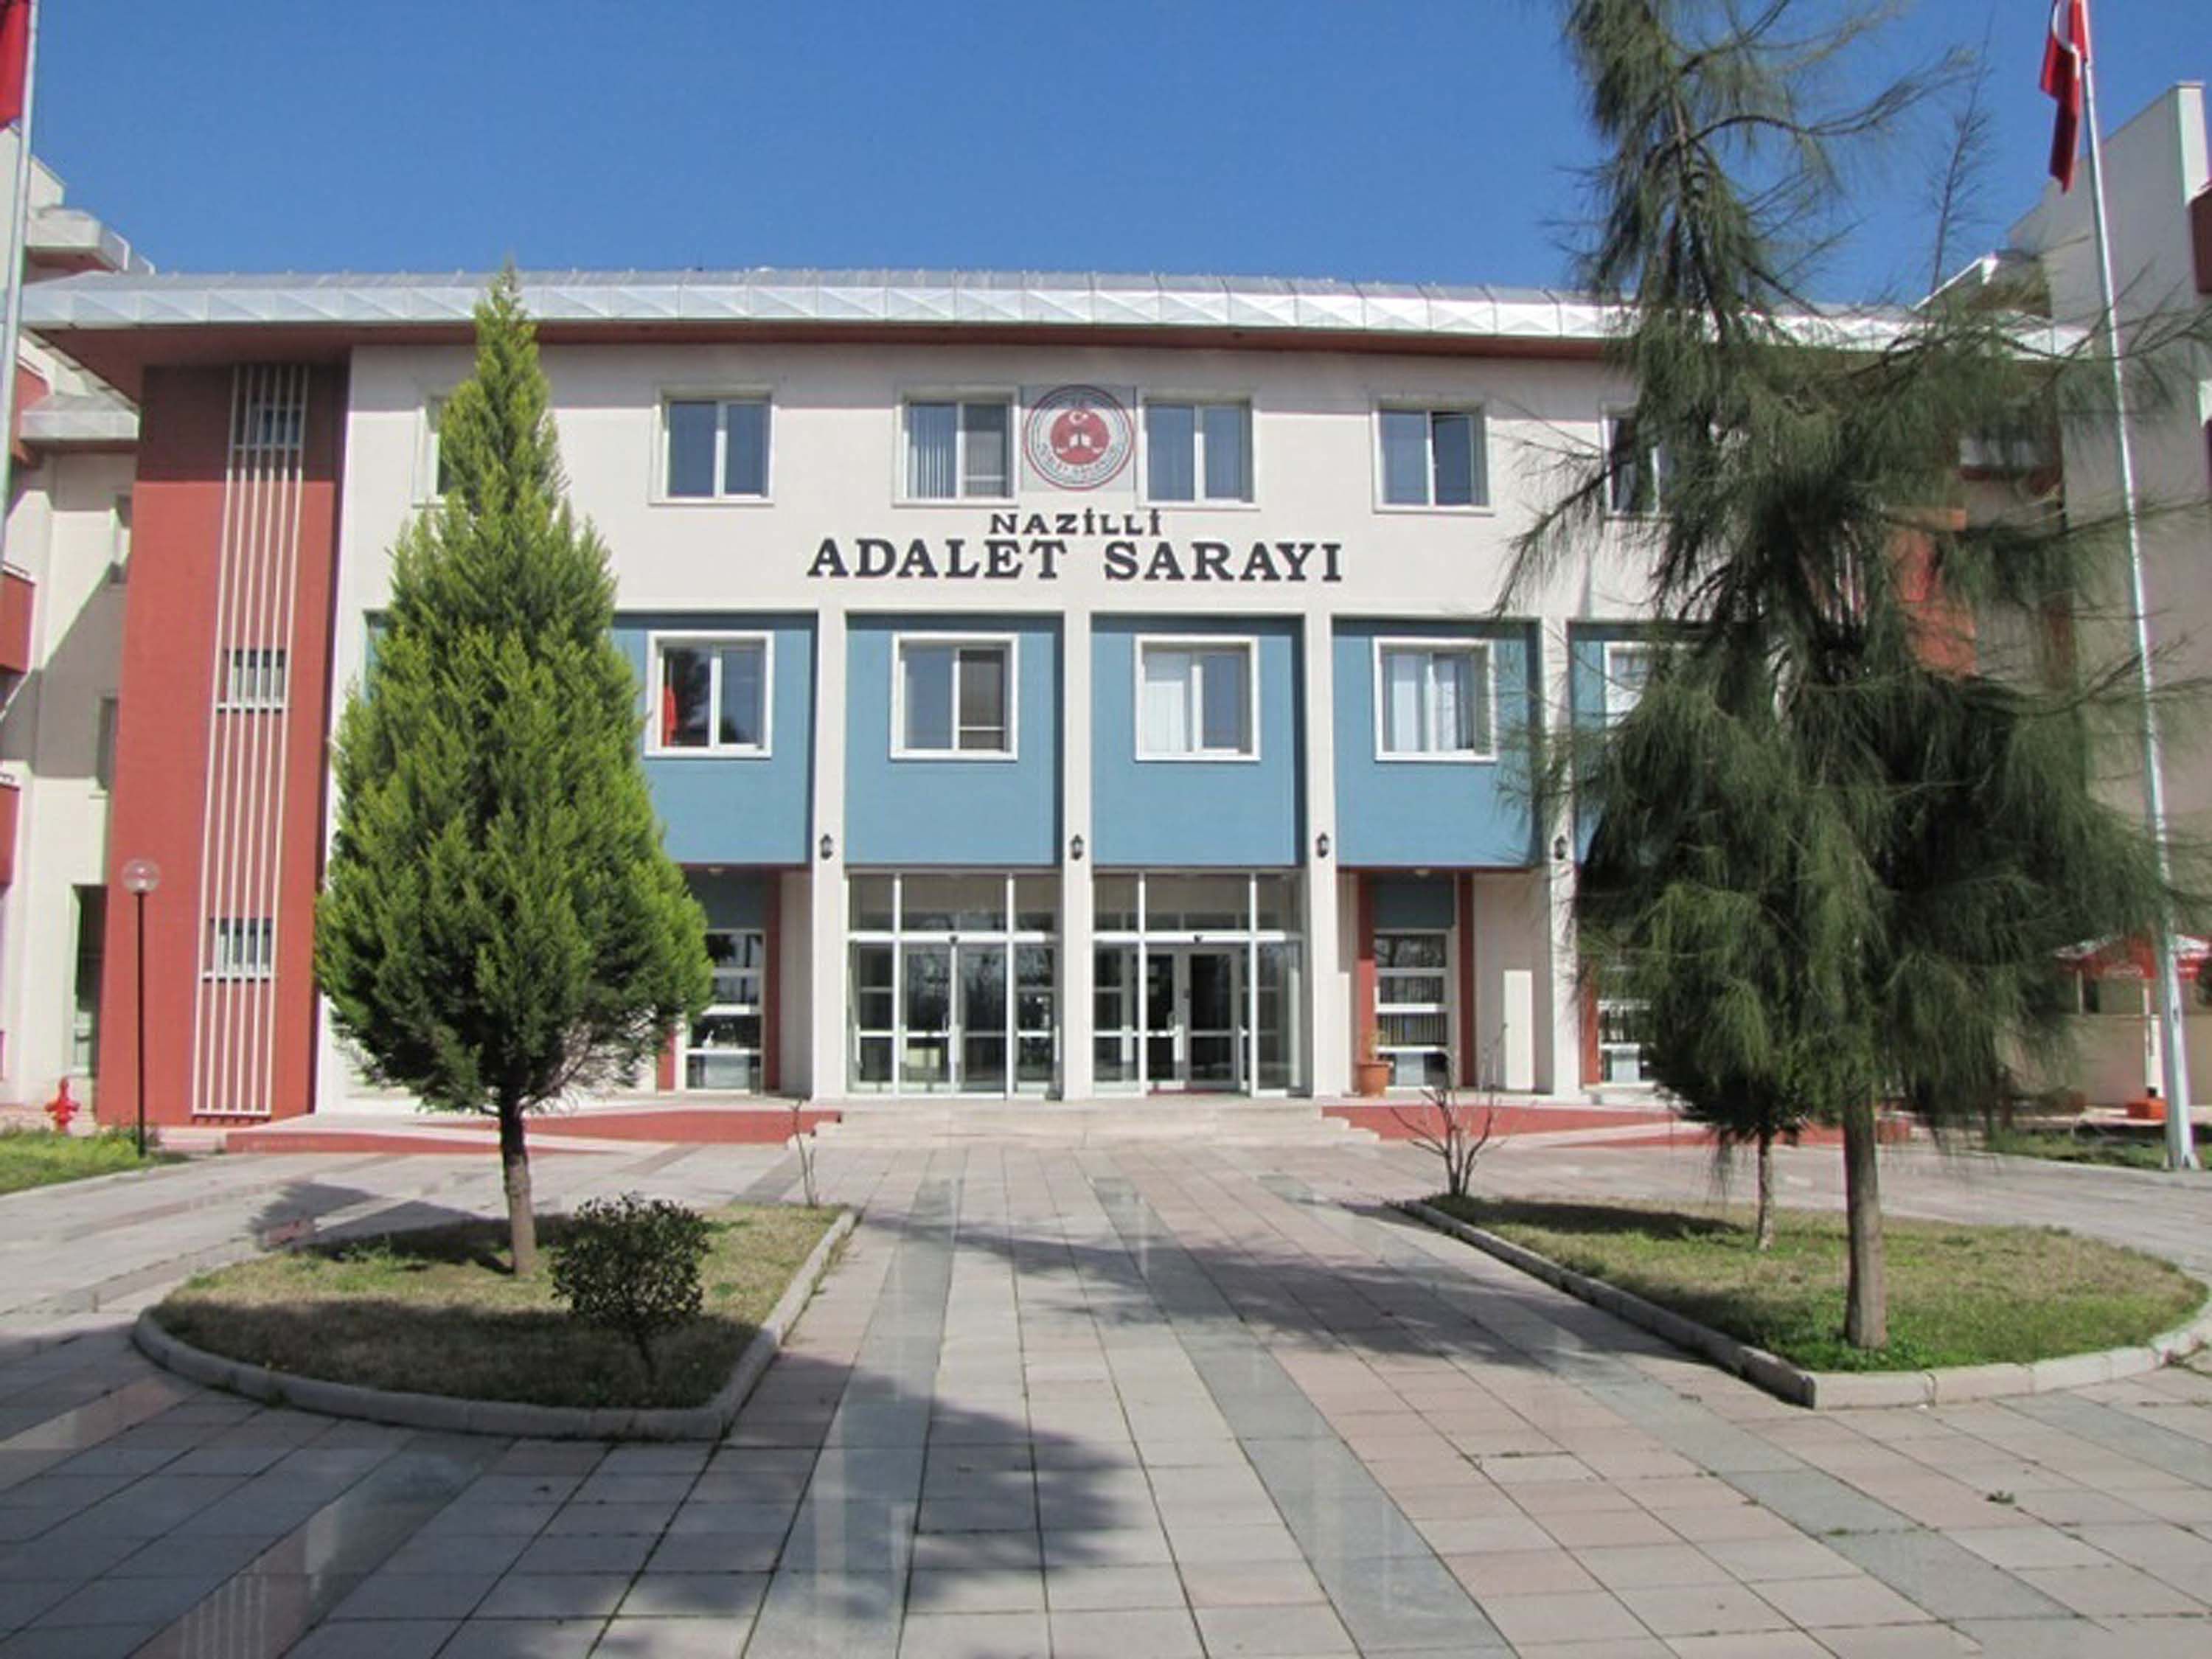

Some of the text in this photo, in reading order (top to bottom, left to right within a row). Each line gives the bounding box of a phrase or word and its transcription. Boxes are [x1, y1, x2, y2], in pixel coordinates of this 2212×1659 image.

[989, 507, 1161, 536] NAZİLLİ
[807, 538, 1342, 582] ADALET SARAYI
